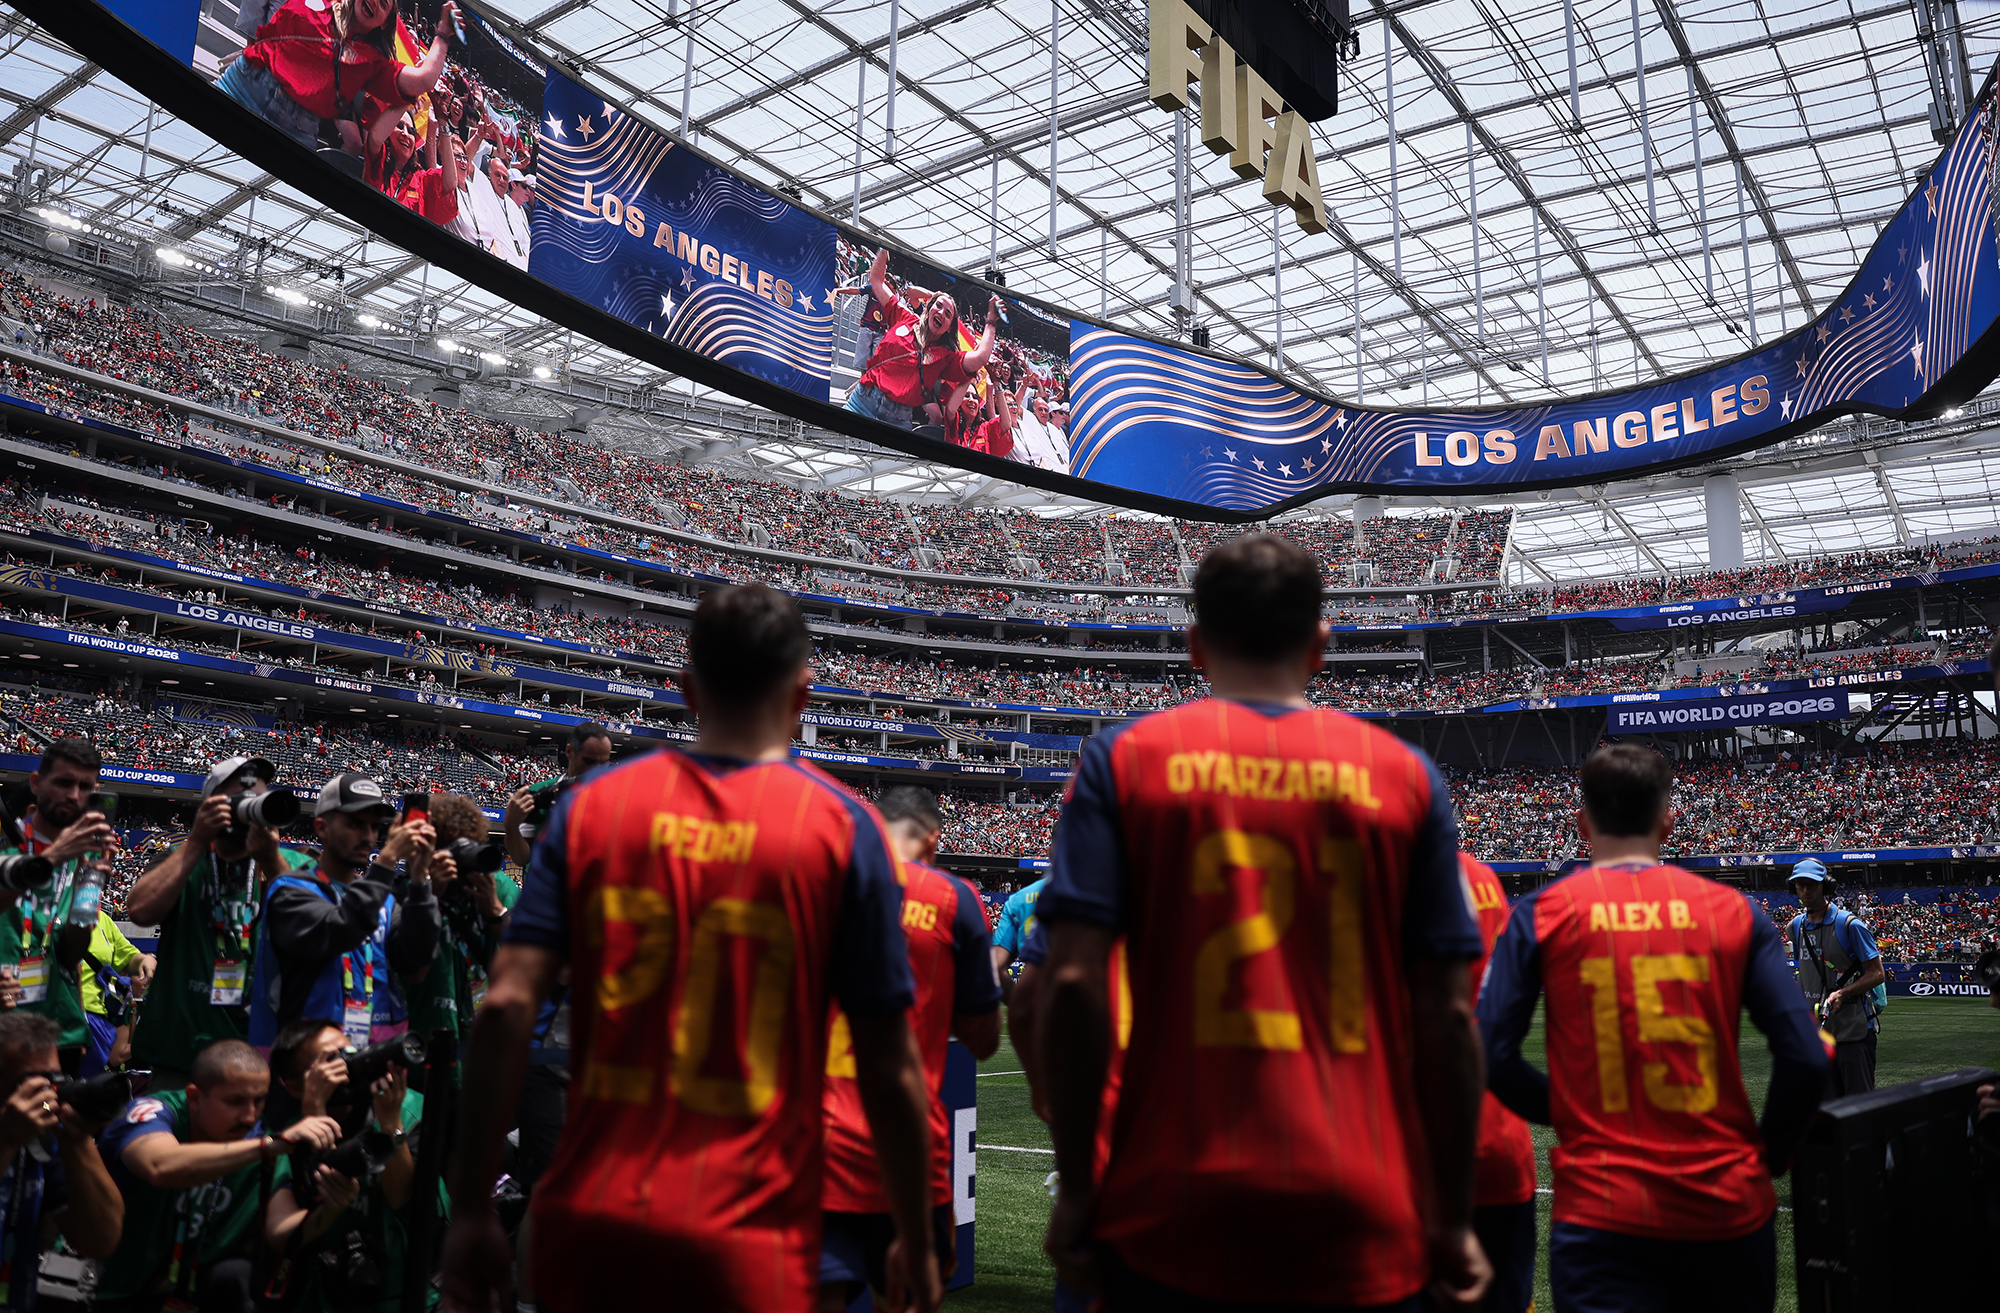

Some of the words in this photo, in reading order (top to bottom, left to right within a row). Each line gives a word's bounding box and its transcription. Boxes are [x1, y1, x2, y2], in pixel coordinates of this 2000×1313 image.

[513, 50, 526, 61] CUP
[1149, 0, 1328, 235] FIFA
[583, 180, 646, 238] LOS
[653, 221, 795, 308] ANGELES
[1415, 431, 1518, 467] LOS
[1533, 374, 1771, 461] ANGELES
[140, 434, 154, 442] LOS
[154, 438, 181, 450] ANGELES
[317, 482, 334, 490] WORLD
[177, 563, 190, 571] FIFA
[190, 566, 211, 575] WORLD
[223, 573, 243, 582] 2026
[1825, 587, 1845, 596] LOS
[1846, 581, 1892, 593] ANGELES
[177, 603, 219, 620] LOS
[223, 613, 315, 639] ANGELES
[1667, 615, 1703, 627] LOS
[1708, 605, 1796, 623] ANGELES
[68, 633, 90, 645] FIFA
[91, 637, 126, 651] WORLD
[126, 644, 146, 654] CUP
[146, 647, 179, 660] 2026
[315, 676, 332, 686] LOS
[333, 680, 372, 692] ANGELES
[1808, 676, 1835, 688] LOS
[1838, 670, 1903, 686] ANGELES
[607, 683, 654, 699] #FIFAWorldCup
[1613, 692, 1660, 703] #FIFAWorldCup
[1618, 711, 1657, 726] FIFA
[1658, 706, 1725, 724] WORLD
[1727, 703, 1765, 719] CUP
[1768, 697, 1836, 717] 2026
[800, 713, 818, 723] FIFA
[819, 716, 852, 727] WORLD
[853, 719, 872, 728] CUP
[872, 721, 904, 732] 2026
[667, 731, 680, 740] LOS
[800, 750, 812, 758] FIFA
[812, 751, 833, 760] WORLD
[100, 768, 125, 779] ORLD
[125, 771, 143, 780] CUP
[144, 773, 175, 784] 2026
[961, 765, 973, 773] LOS
[975, 766, 1006, 774] ANGELES
[1167, 750, 1382, 811] OYARZABAL
[293, 789, 309, 799] LOS
[650, 812, 759, 864] PEDRI
[1590, 902, 1664, 932] ALEX
[1669, 899, 1698, 930] B.
[1194, 829, 1367, 1054] 21
[1938, 984, 1991, 995] HYUND
[586, 885, 795, 1116] 20
[1580, 954, 1719, 1114] 15
